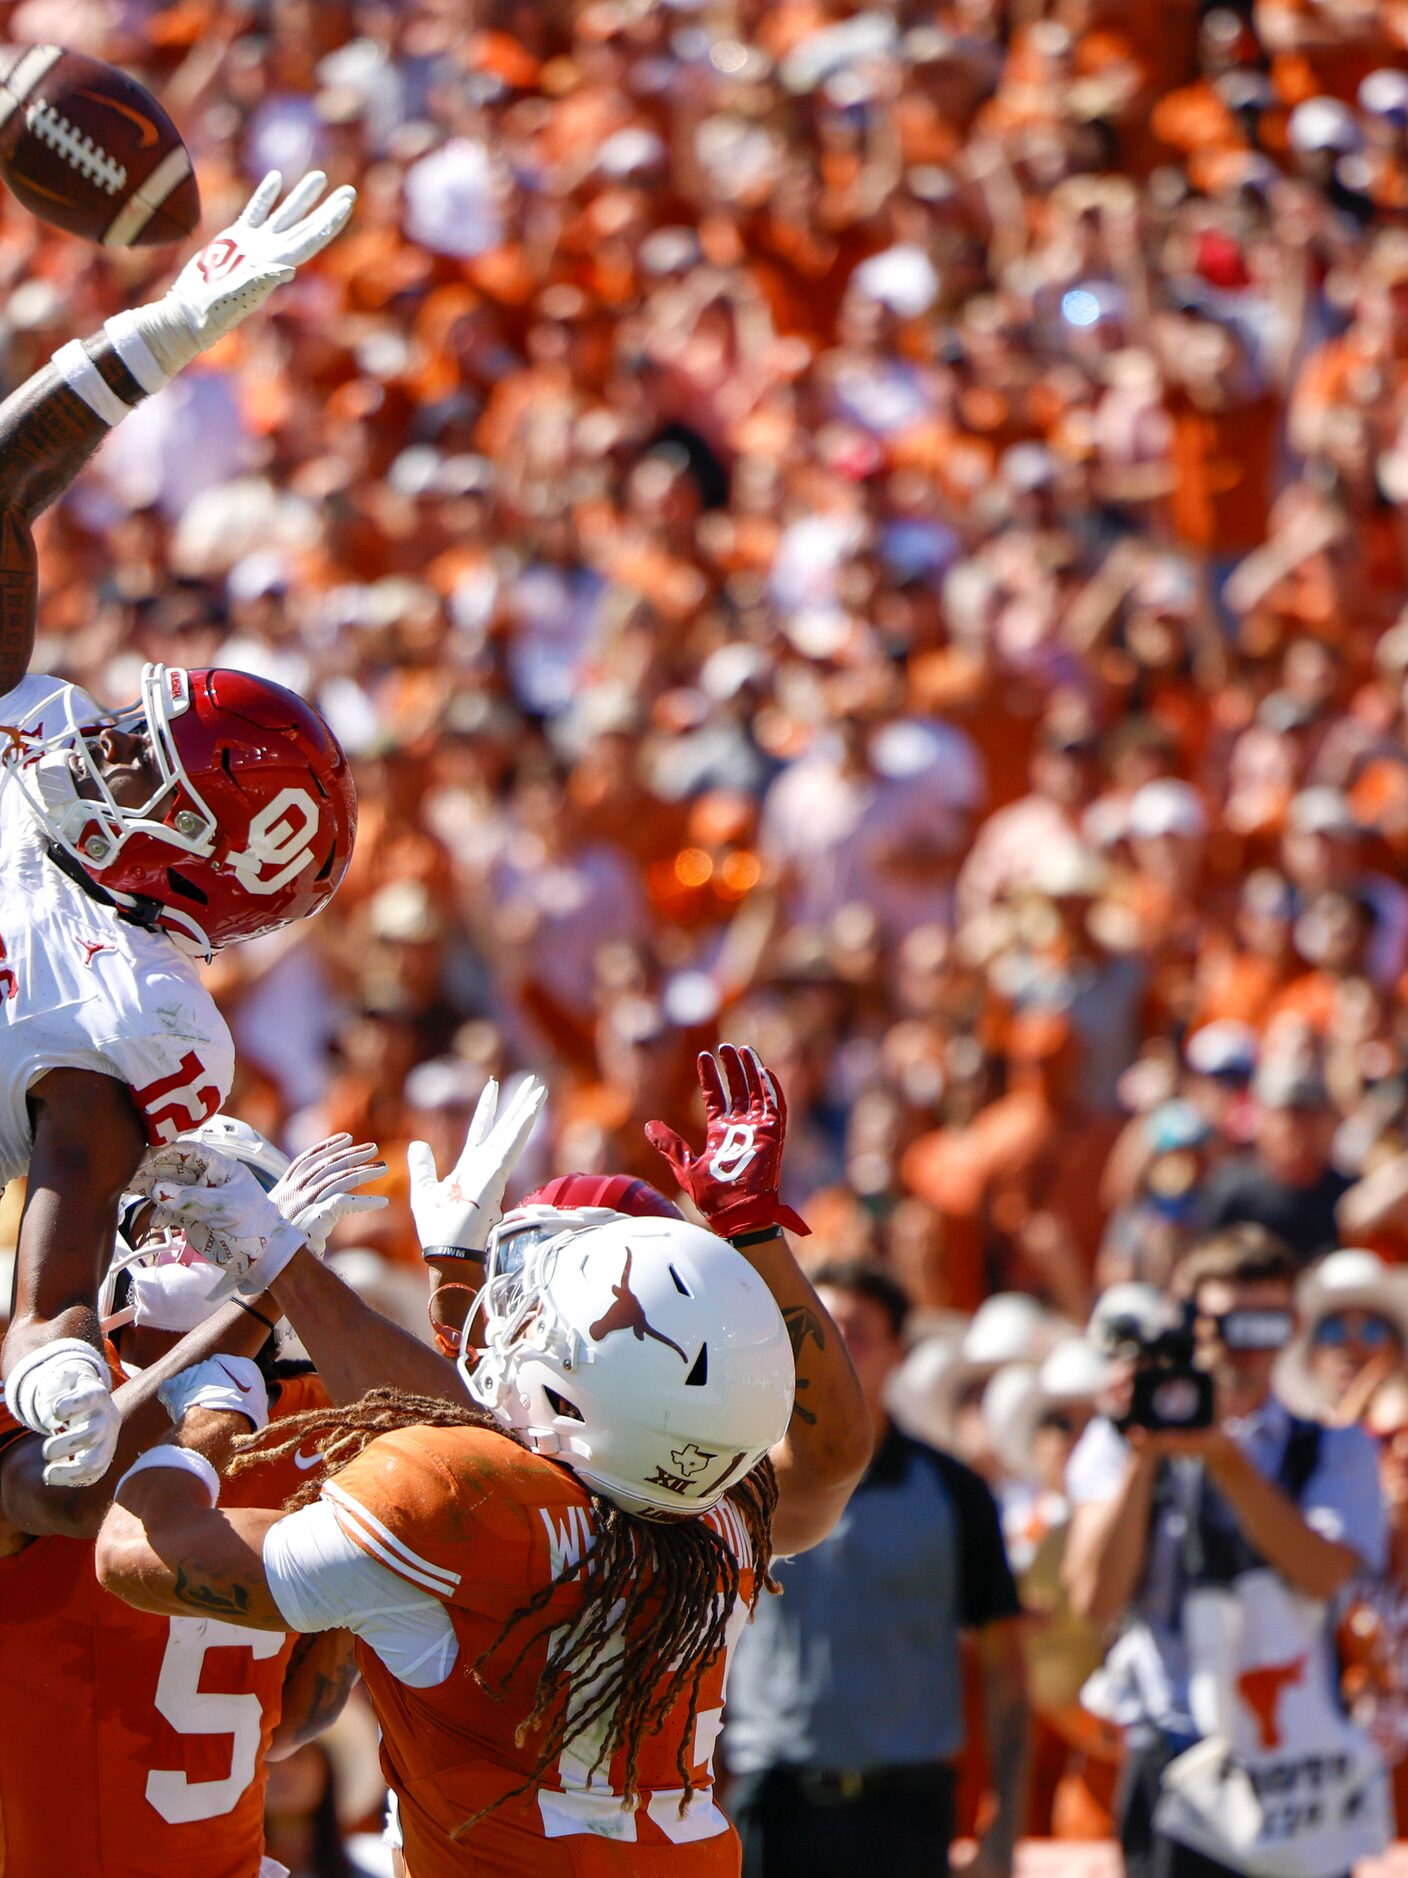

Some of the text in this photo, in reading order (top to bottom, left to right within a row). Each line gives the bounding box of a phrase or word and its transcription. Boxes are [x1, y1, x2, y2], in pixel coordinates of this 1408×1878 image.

[234, 787, 320, 896] OU
[129, 1051, 222, 1148] 12
[709, 1123, 757, 1183] OU
[644, 1464, 697, 1496] XII
[144, 1615, 287, 1824] 5
